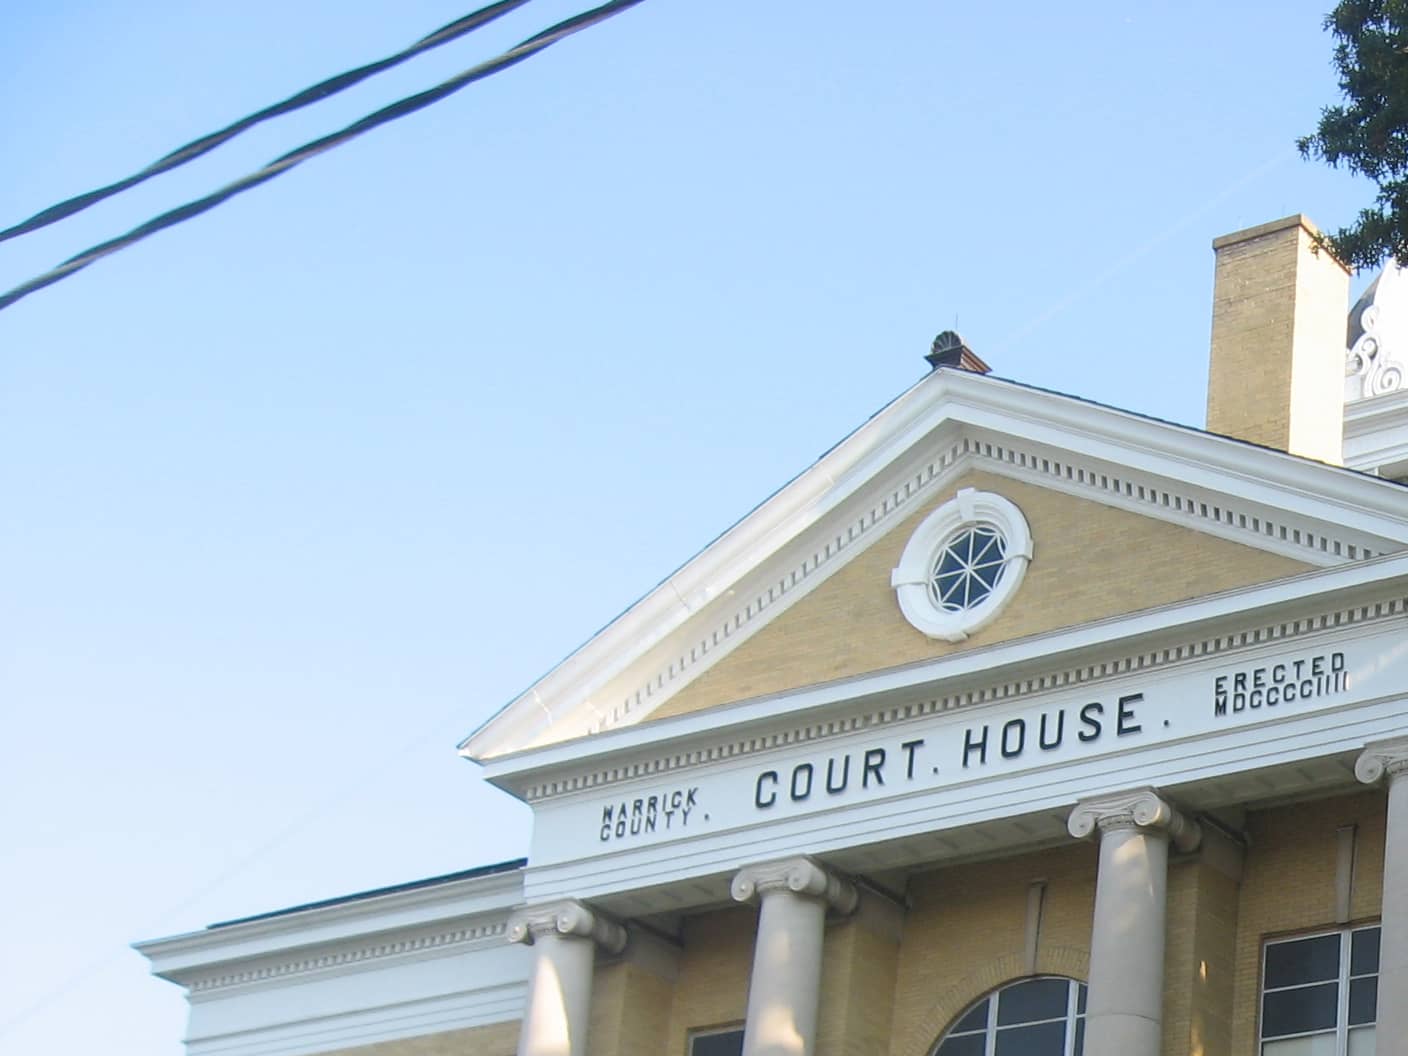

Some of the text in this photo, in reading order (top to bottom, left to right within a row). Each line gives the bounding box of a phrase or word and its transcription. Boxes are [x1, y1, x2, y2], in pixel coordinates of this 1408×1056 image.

[1215, 652, 1345, 697] ERECTED
[1215, 671, 1348, 716] MDCCCCIIII
[602, 787, 699, 824] WARRICK
